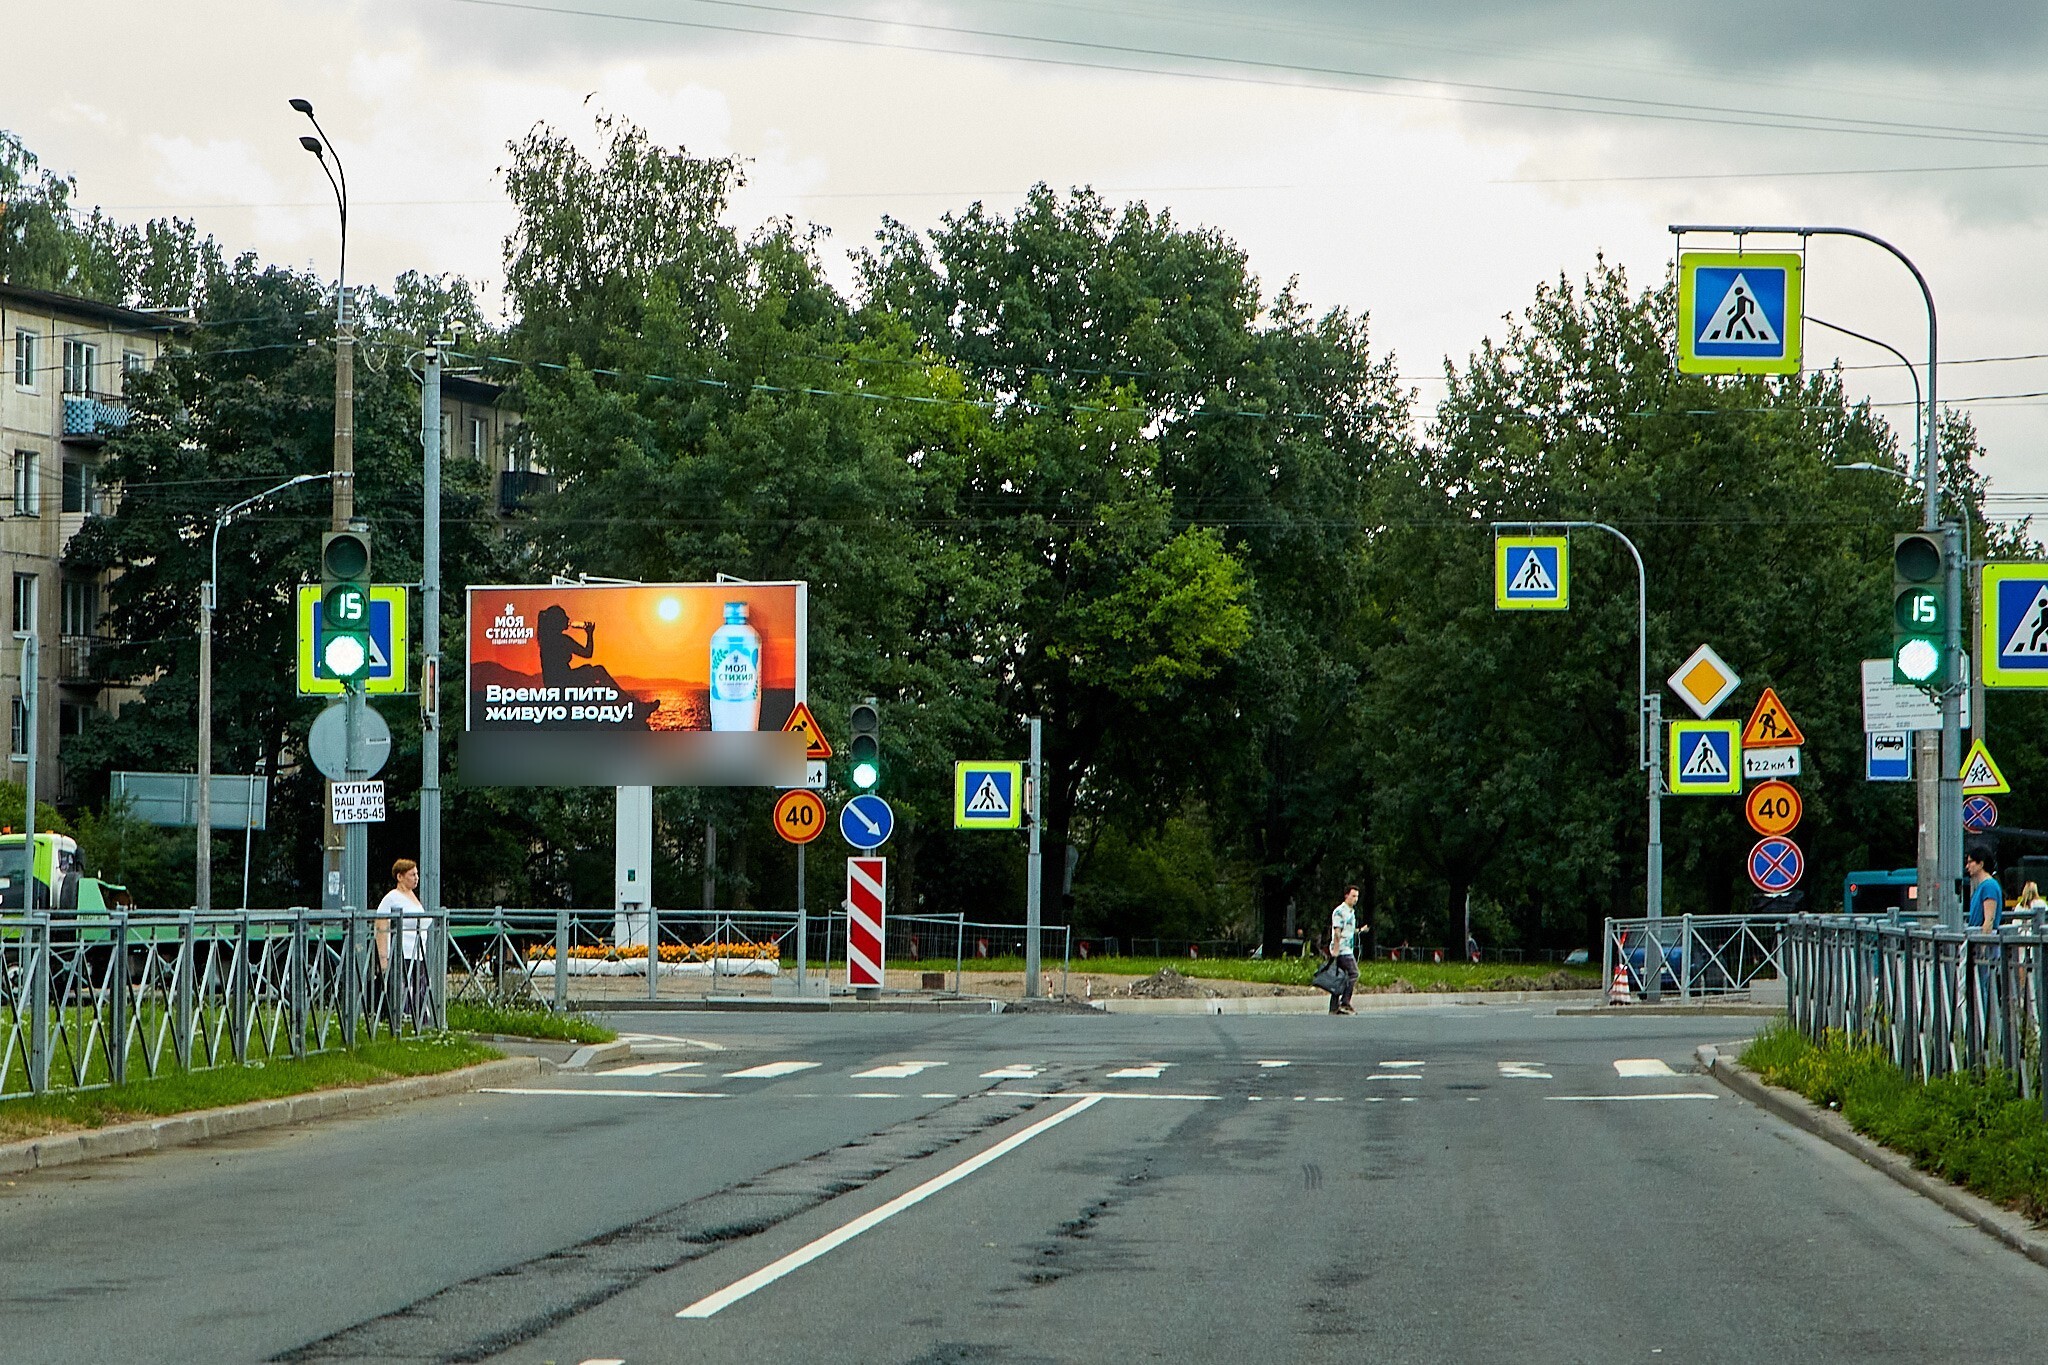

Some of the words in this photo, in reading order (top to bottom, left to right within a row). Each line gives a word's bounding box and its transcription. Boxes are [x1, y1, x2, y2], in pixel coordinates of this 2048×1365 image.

[339, 592, 362, 620] 15
[1912, 595, 1936, 623] 15
[494, 615, 524, 628] МОЯ
[485, 627, 534, 639] СТИХИЯ
[725, 664, 747, 673] МОЯ
[718, 673, 754, 682] СТИХИЯ
[485, 684, 560, 705] Время
[564, 686, 619, 702] пить
[485, 705, 567, 724] живую
[571, 701, 634, 724] воду!
[334, 784, 383, 795] КУПИМ
[334, 797, 355, 807] ВАШ
[360, 796, 384, 806] АВТО
[1759, 798, 1790, 818] 40
[334, 808, 385, 821] 715-55-45
[786, 805, 813, 826] 40
